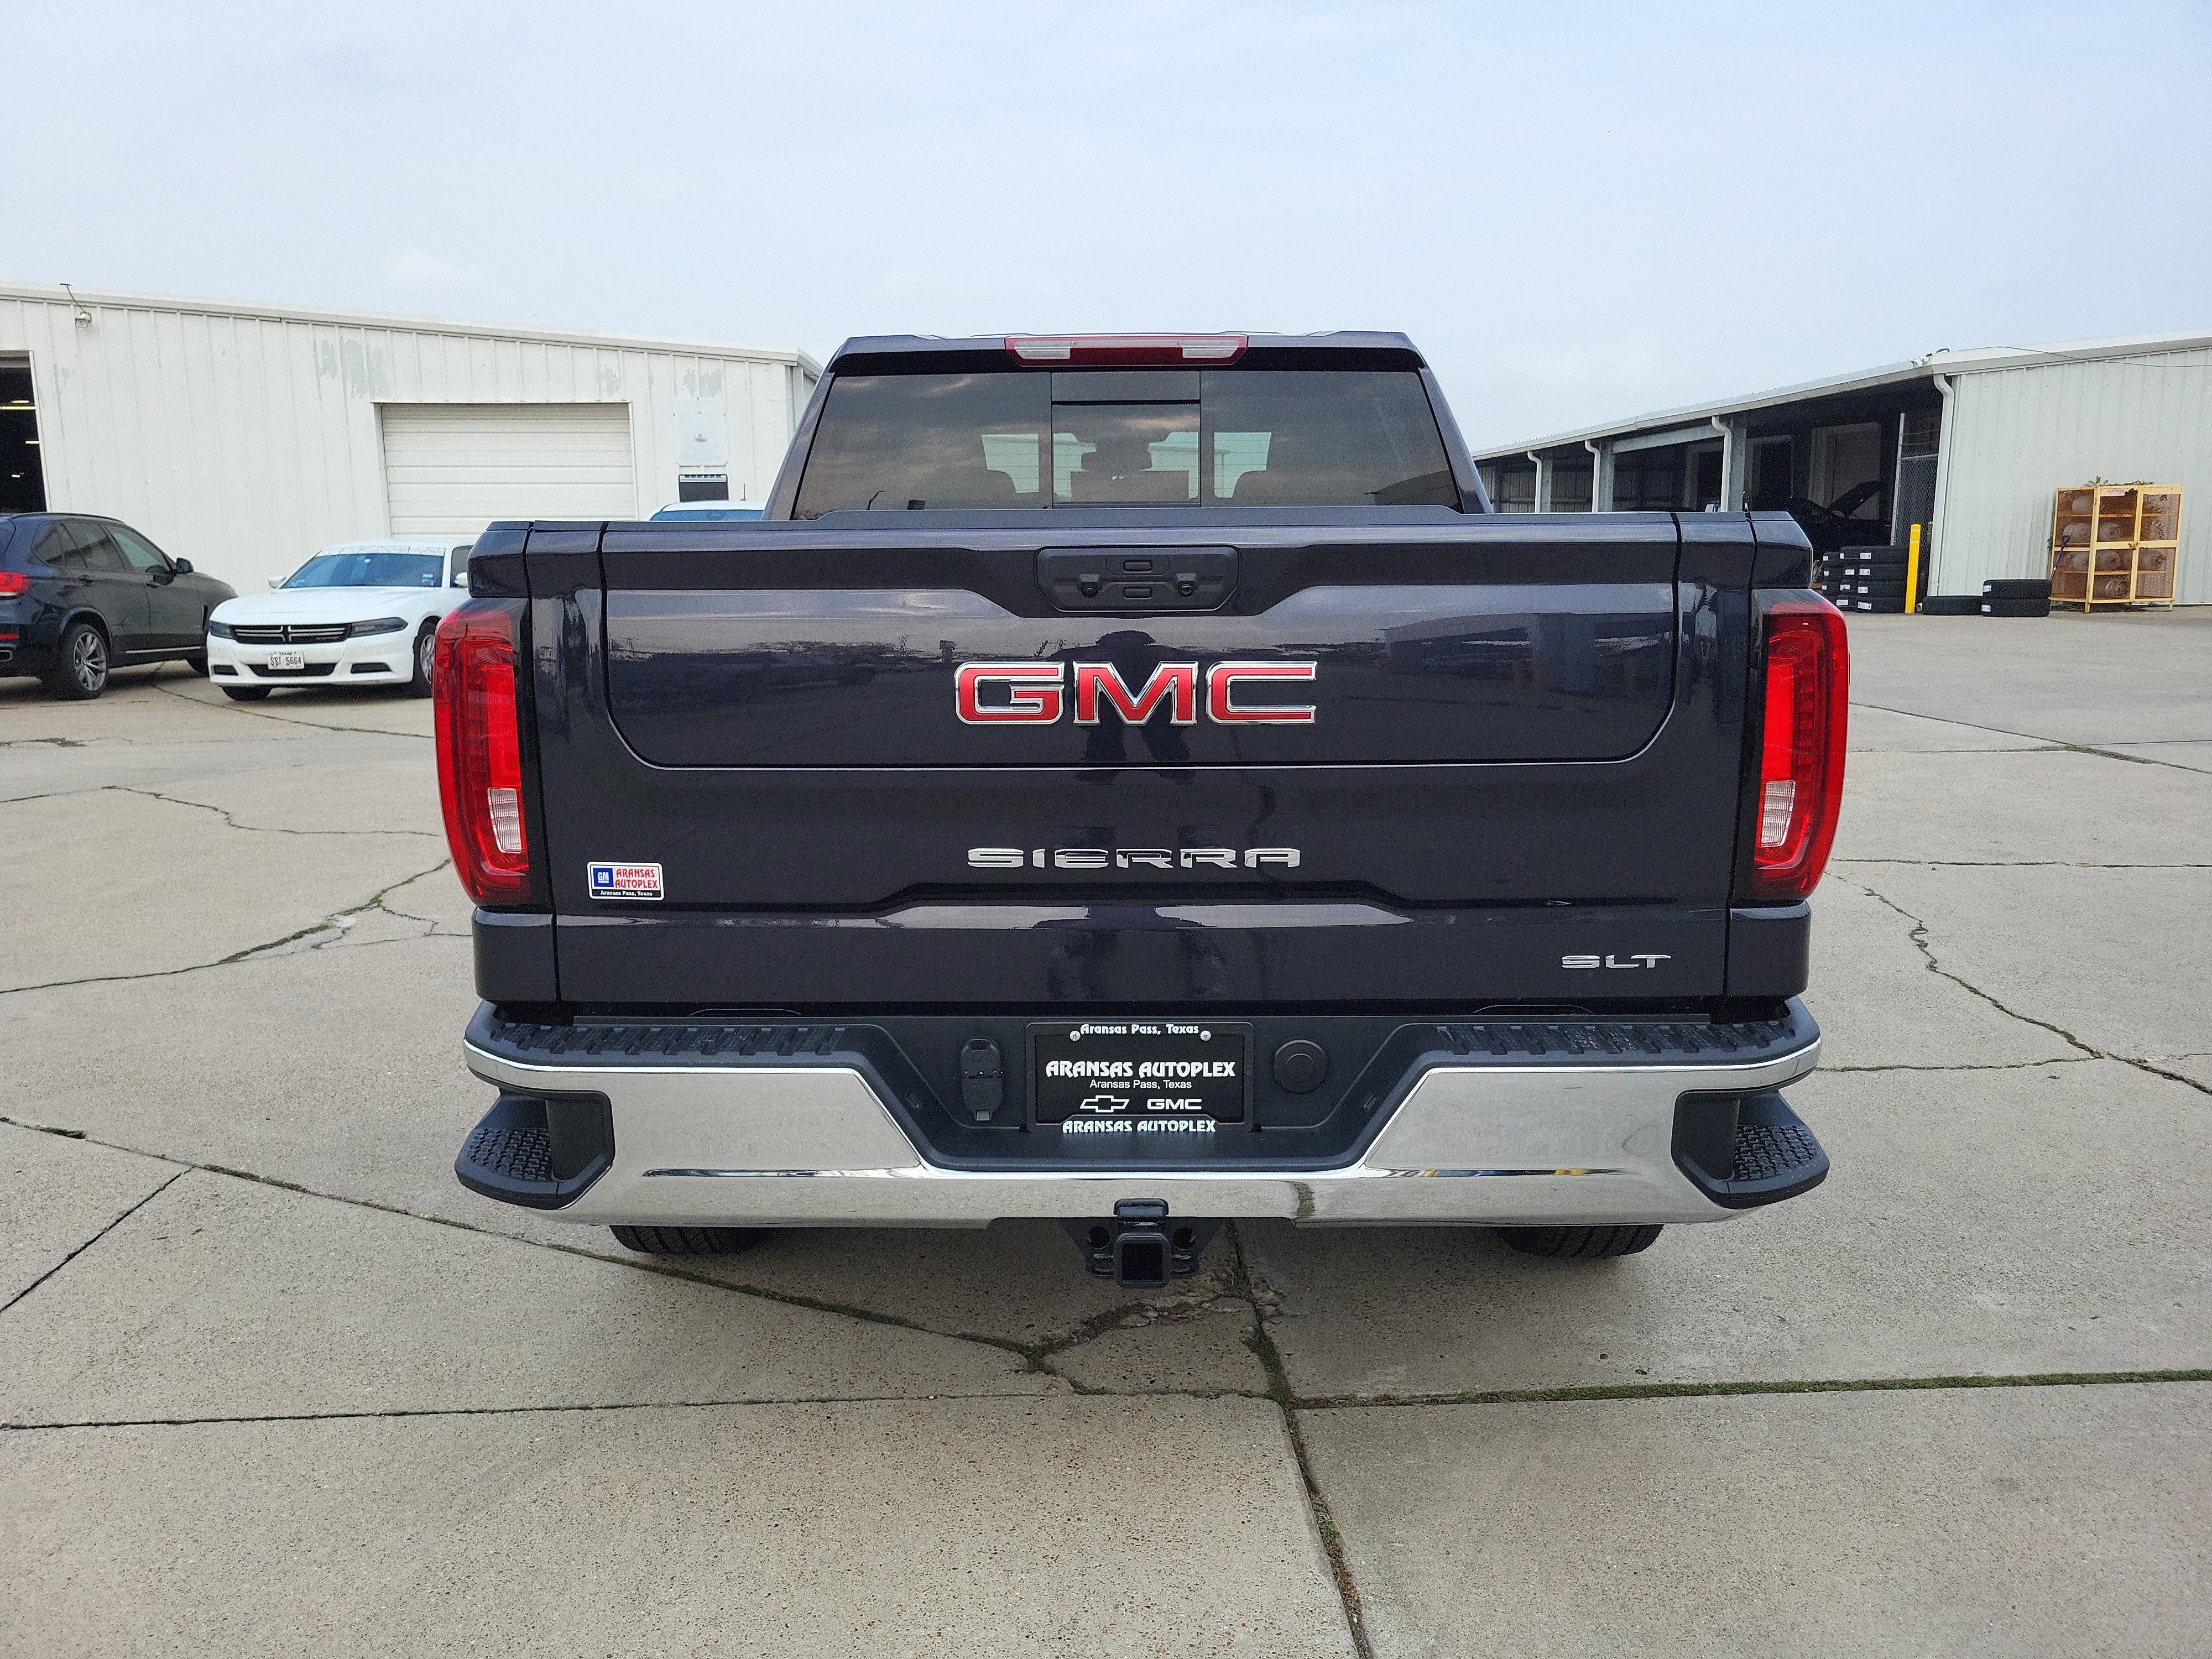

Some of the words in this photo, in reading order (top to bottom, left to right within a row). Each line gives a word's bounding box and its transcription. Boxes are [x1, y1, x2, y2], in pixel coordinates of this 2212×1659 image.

[954, 661, 1317, 726] GMC
[968, 848, 1301, 868] SIERRA
[597, 872, 609, 881] GM
[616, 869, 655, 878] ARANSAS
[615, 879, 658, 888] AUTOPLEX
[1561, 954, 1671, 968] SLT
[1080, 1024, 1127, 1035] Aransas
[1131, 1024, 1161, 1035] Pass,
[1165, 1024, 1199, 1034] Texas
[1046, 1061, 1134, 1078] ARANSAS
[1139, 1062, 1235, 1078] AUTOPLEX
[1089, 1079, 1130, 1089] Aransas
[1133, 1079, 1161, 1090] Pass,
[1163, 1079, 1192, 1089] Texas
[1147, 1098, 1202, 1110] GMC
[1062, 1120, 1133, 1133] ARANSAS
[1137, 1120, 1216, 1133] AUTOPLEX
